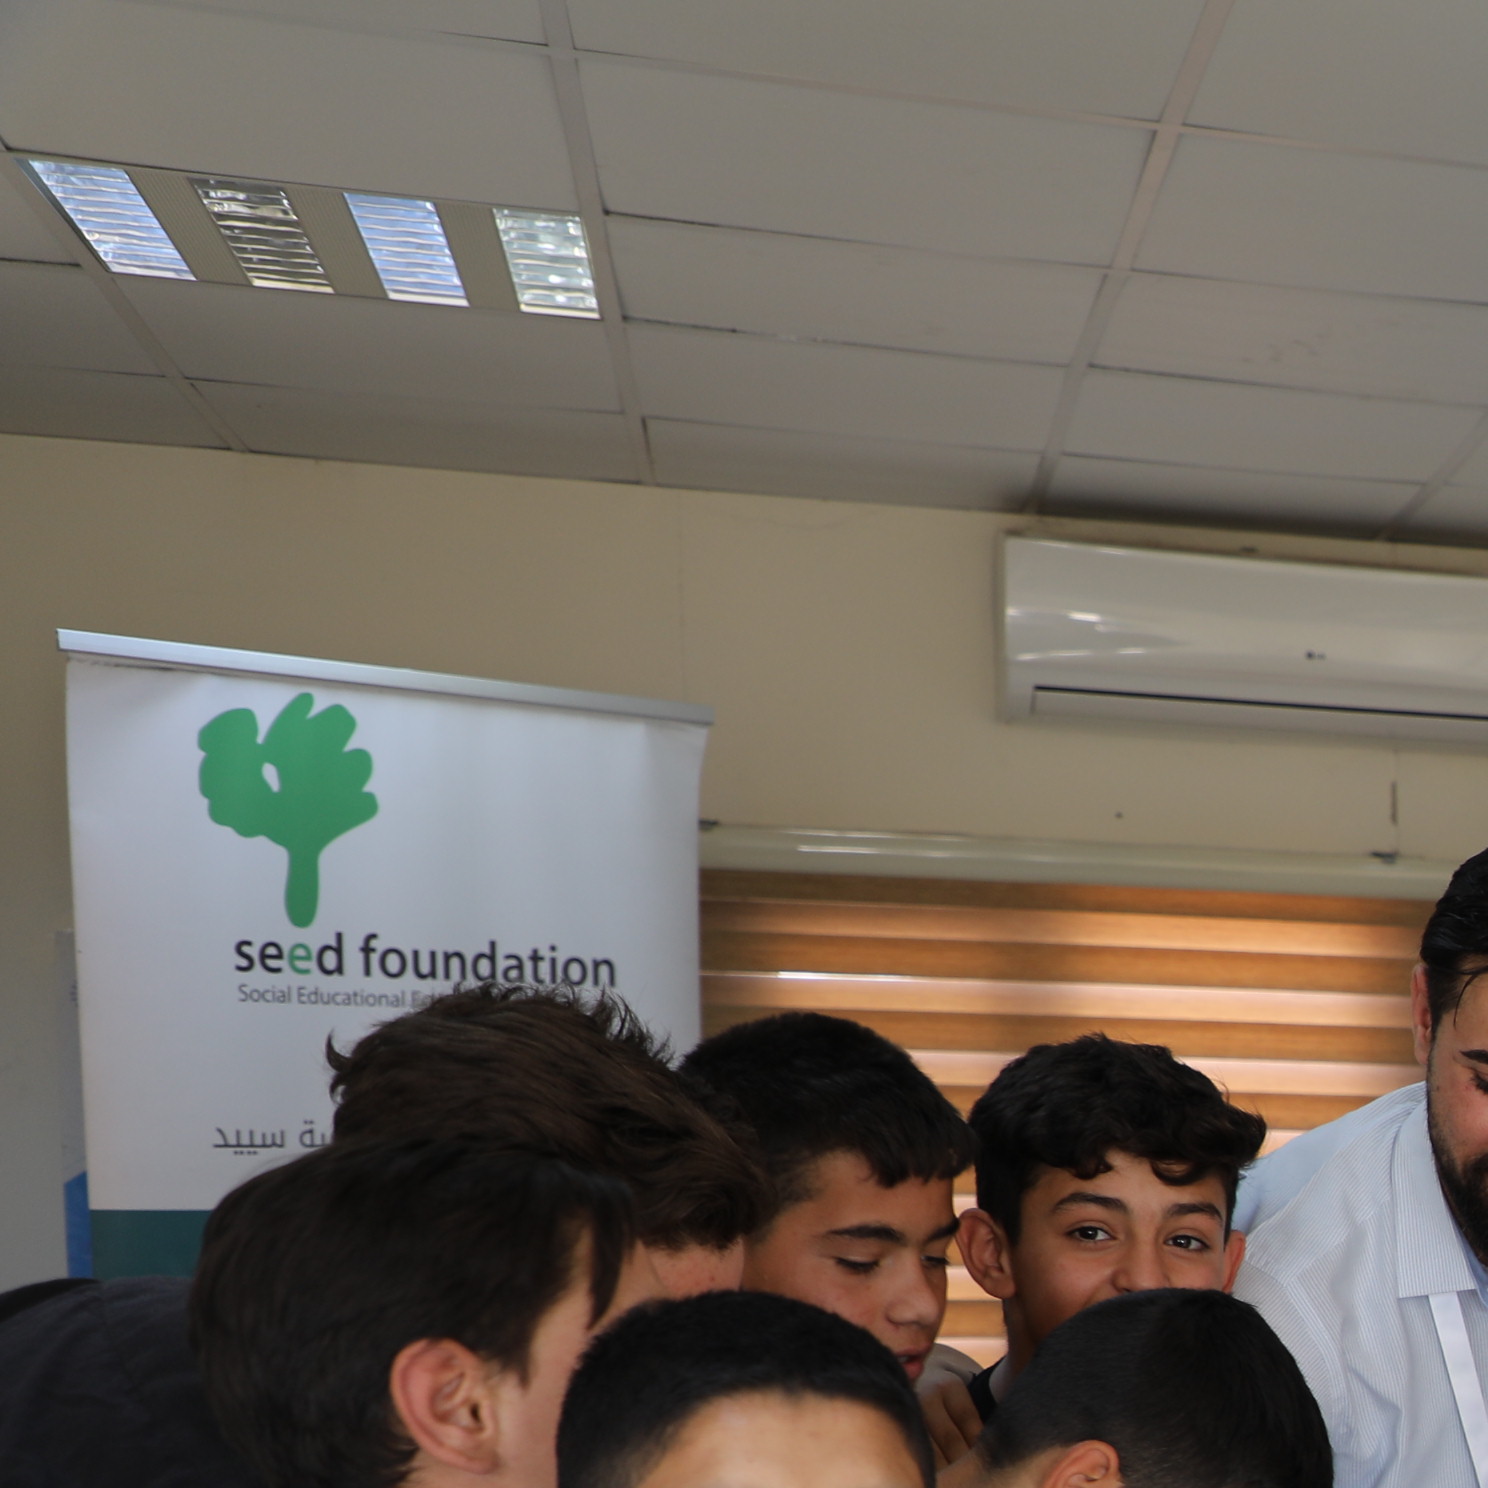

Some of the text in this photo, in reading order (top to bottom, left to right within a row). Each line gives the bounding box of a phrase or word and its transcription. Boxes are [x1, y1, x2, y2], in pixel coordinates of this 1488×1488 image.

[234, 931, 617, 987] seed foundation
[238, 984, 292, 1004] Social
[297, 985, 405, 1008] Educational
